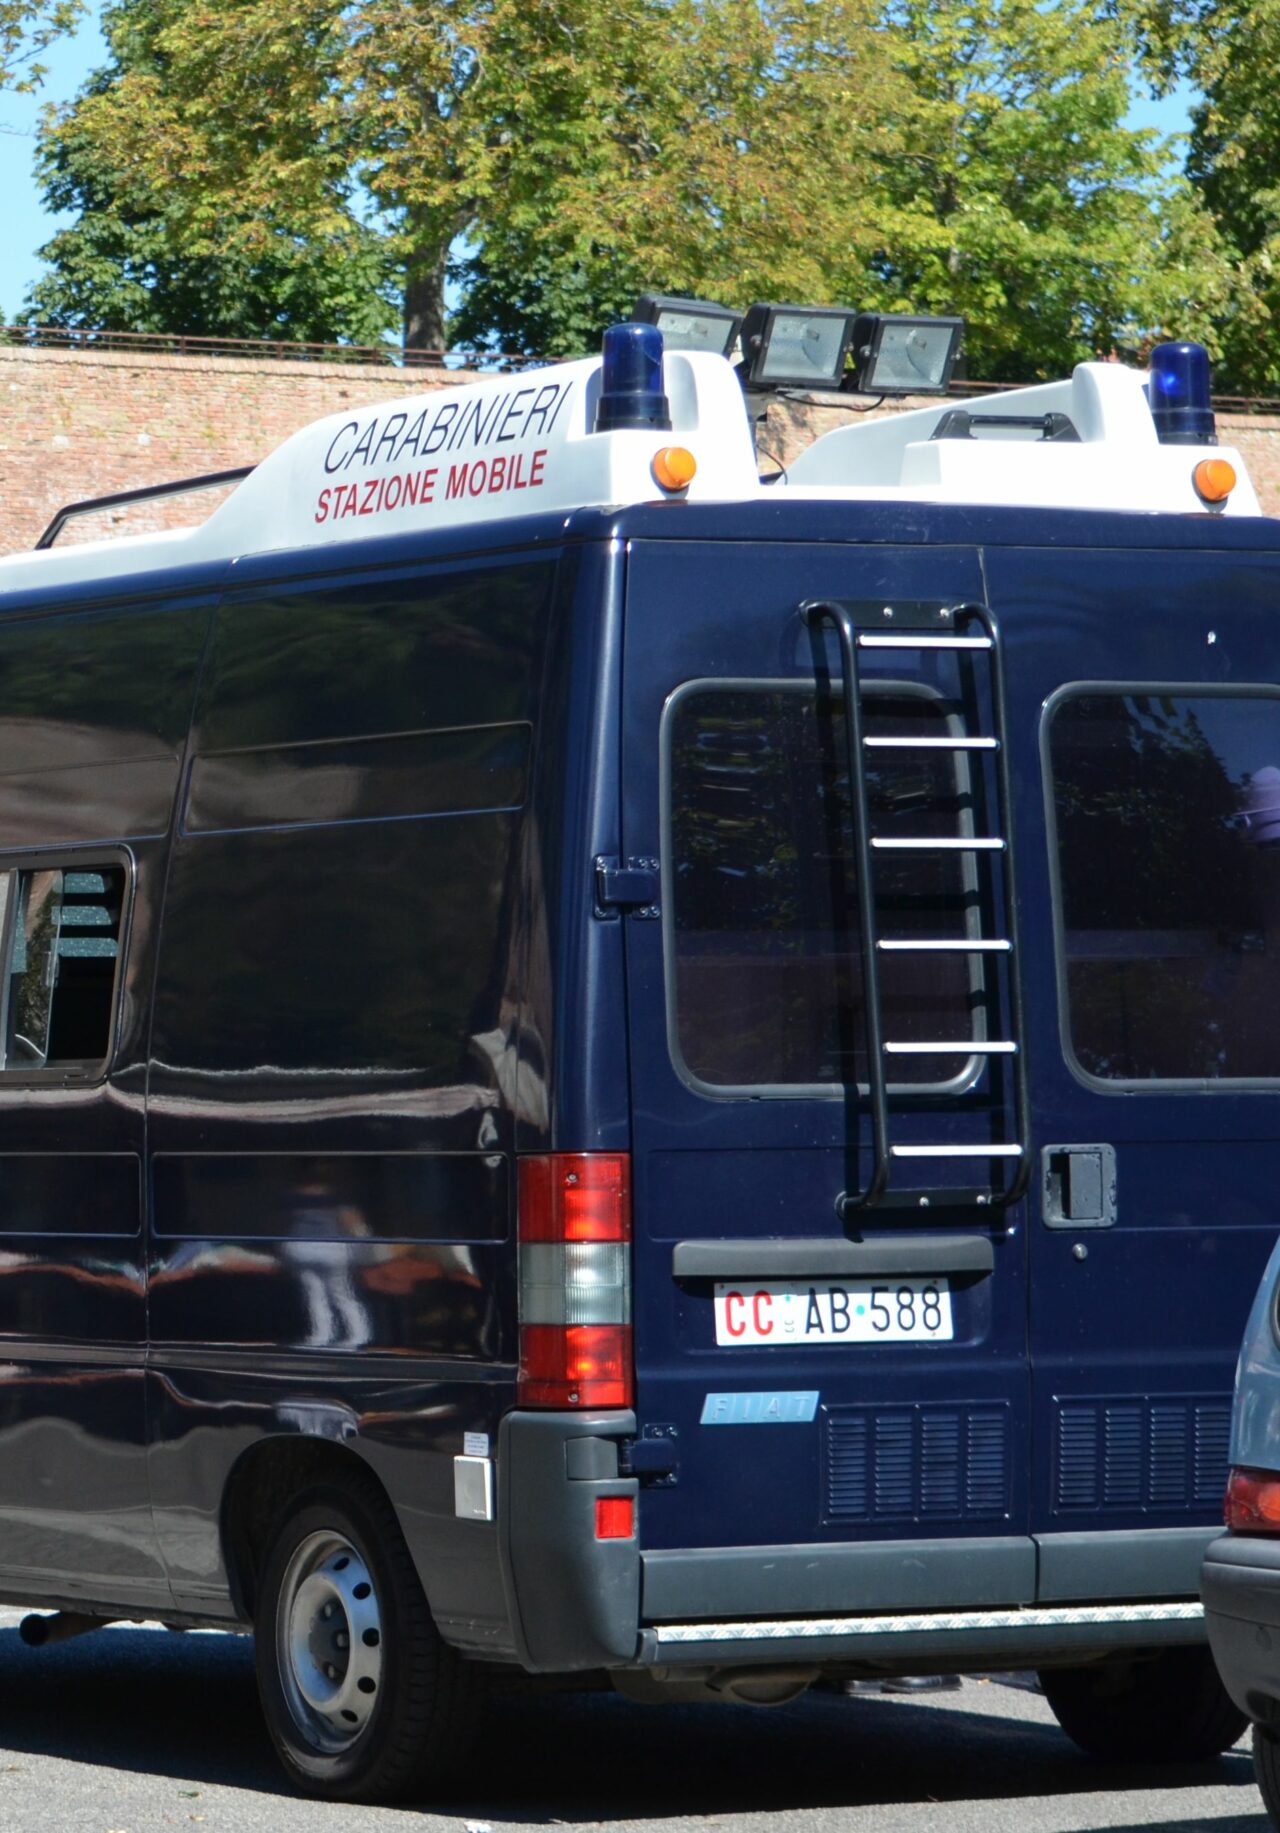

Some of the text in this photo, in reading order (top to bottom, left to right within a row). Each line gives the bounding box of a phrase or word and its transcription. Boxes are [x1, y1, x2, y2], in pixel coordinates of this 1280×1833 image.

[324, 381, 574, 474] CARABINIERI
[314, 449, 548, 523] STAZIONE MOBILE
[724, 1285, 942, 1337] CC AB 588
[711, 1397, 810, 1421] FIAT
